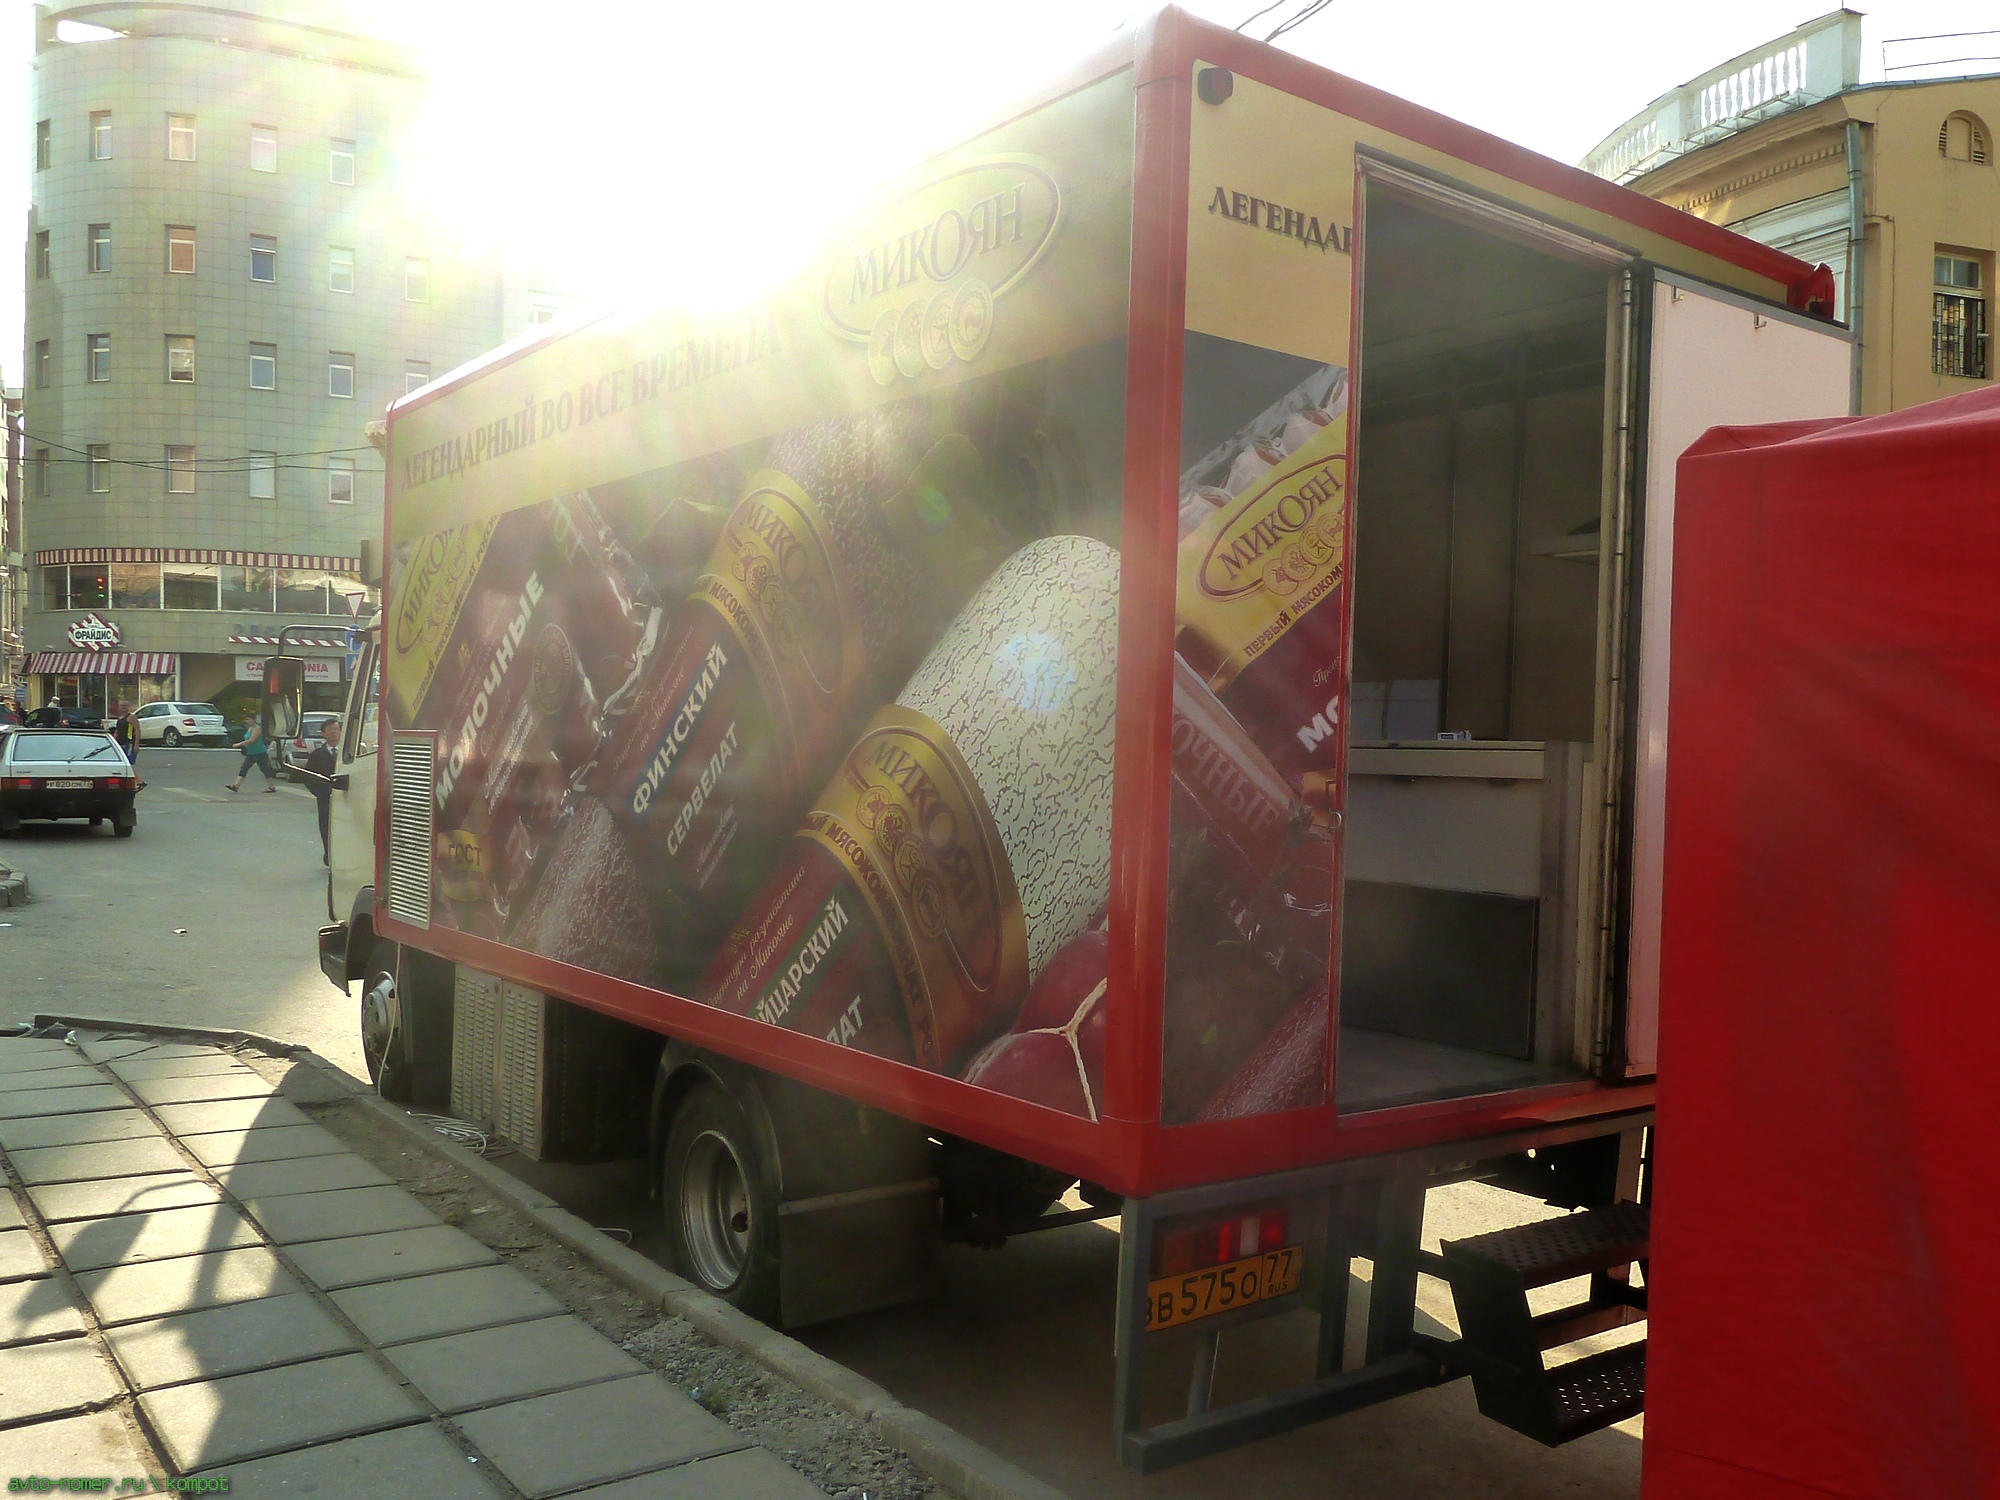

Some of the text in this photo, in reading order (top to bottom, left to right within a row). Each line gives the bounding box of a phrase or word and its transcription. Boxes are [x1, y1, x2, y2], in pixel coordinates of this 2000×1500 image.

[848, 182, 1026, 305] МИКОЯН
[1208, 185, 1352, 254] ЛЕГЕНДАР
[401, 311, 782, 492] ЛЕГЕНДАРНЫЙ ВО ВСЕ ВРЕМЕНА
[1217, 466, 1343, 580] МИКОЯН
[74, 629, 112, 640] ФРАЙДИС
[246, 661, 329, 673] CANIA
[1243, 609, 1291, 657] ПЕРВЫЙ
[436, 569, 545, 812] МОЛОЧНЫЕ
[632, 640, 729, 815] ФИНСКИЙ
[666, 721, 740, 857] СЕРВЕЛАТ
[448, 843, 481, 866] ГОСТ
[750, 866, 806, 956] разработана
[737, 914, 794, 1000] на Микояне
[1267, 1250, 1293, 1283] 77
[1268, 1281, 1288, 1295] RUS
